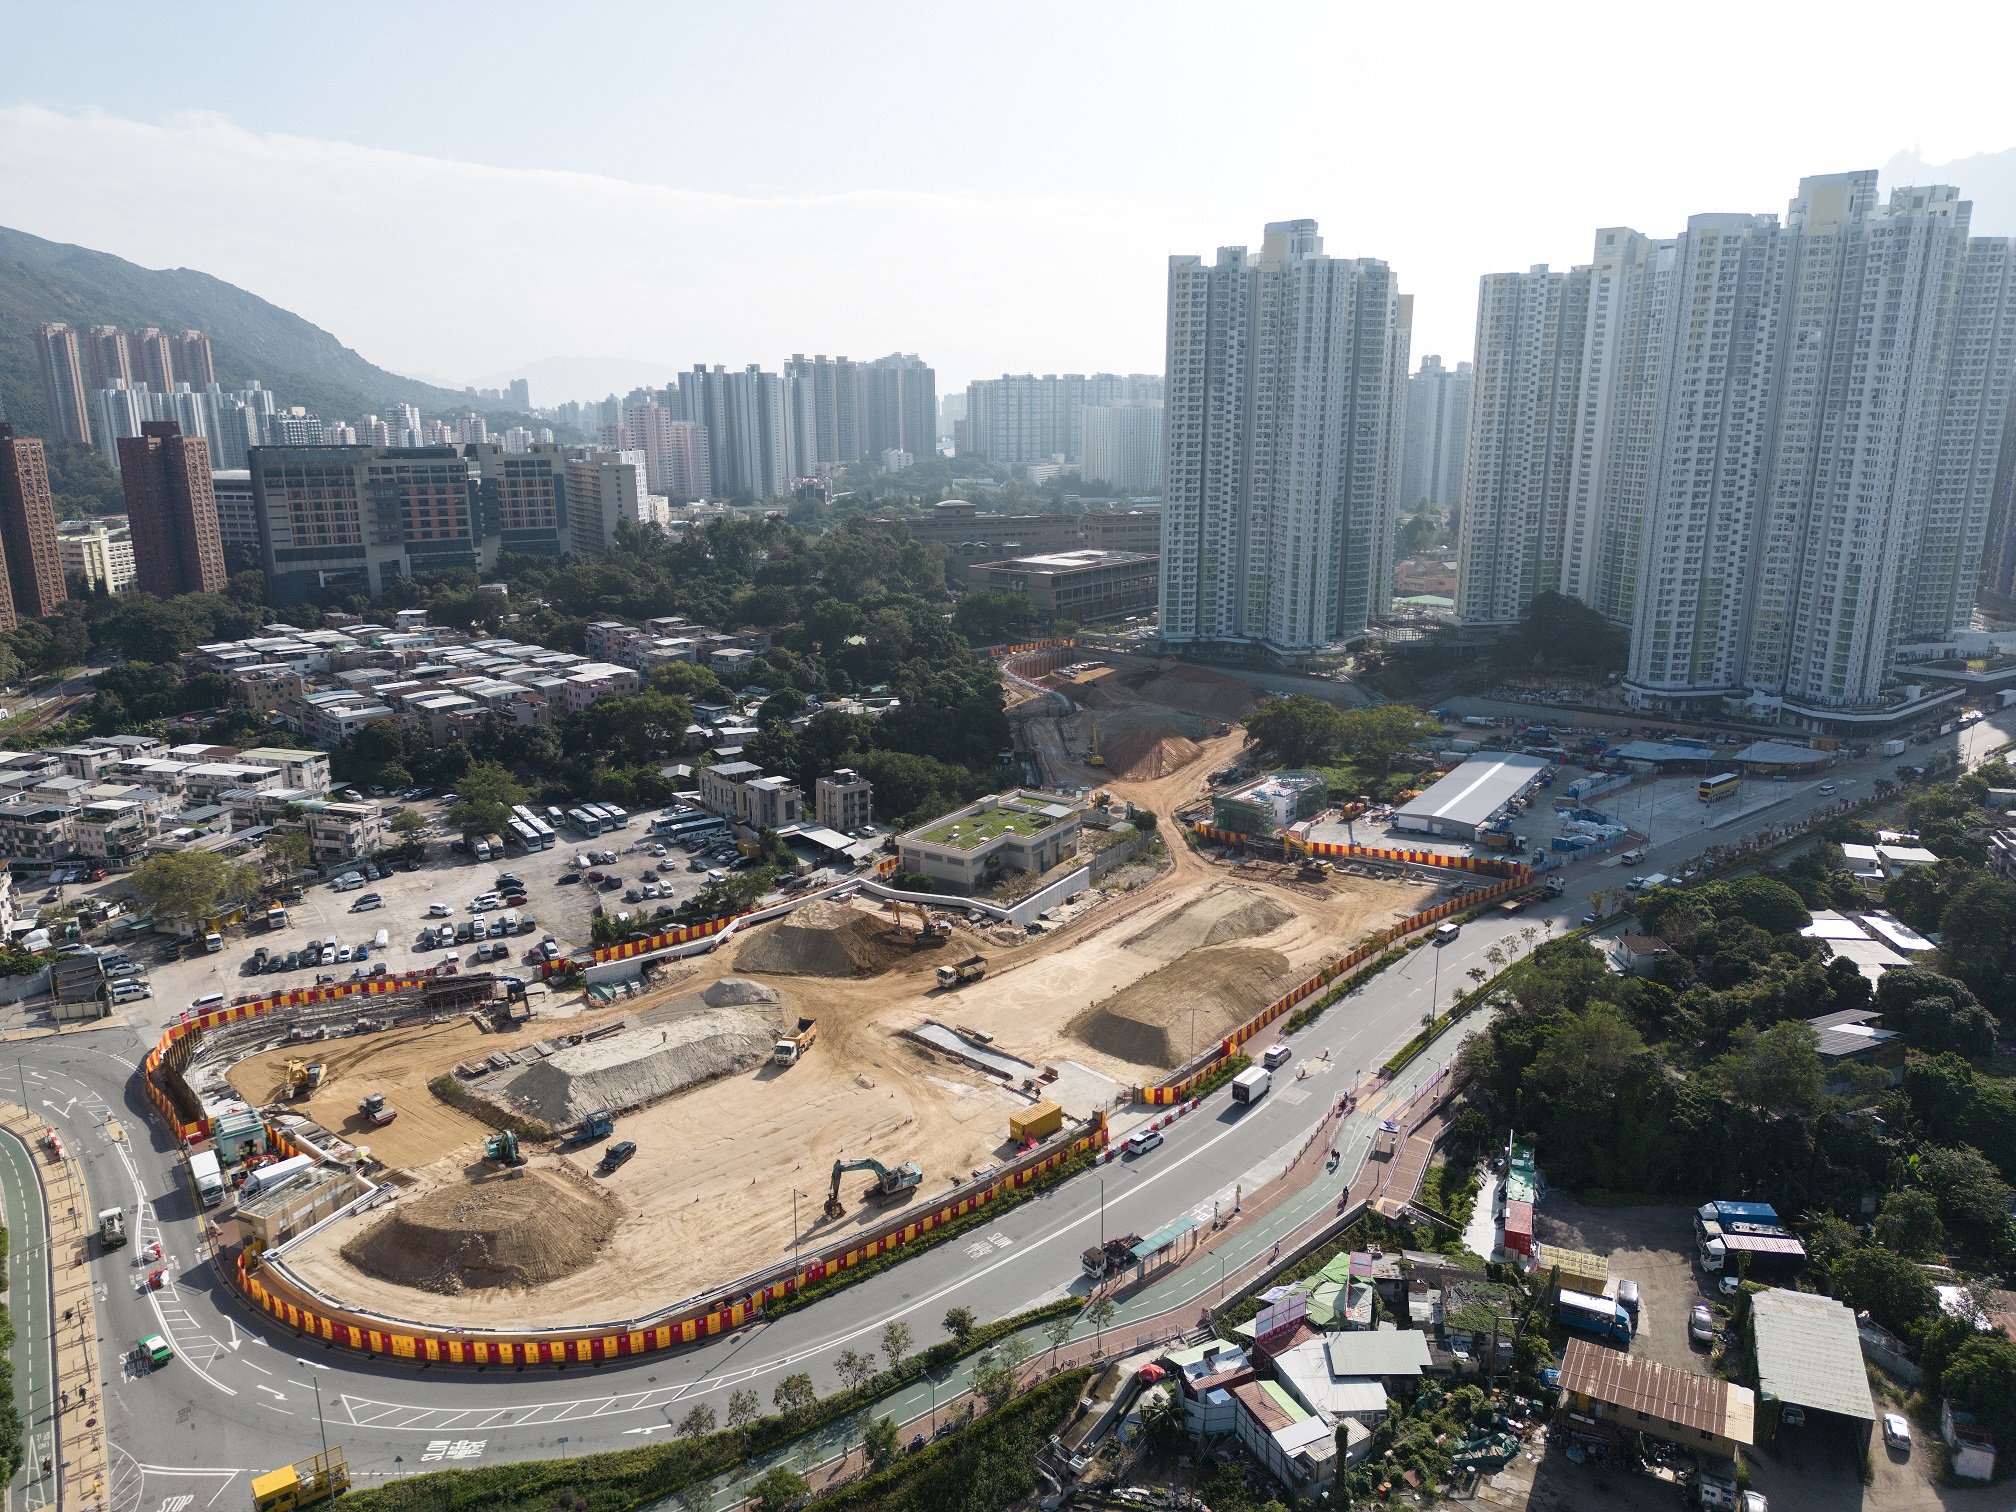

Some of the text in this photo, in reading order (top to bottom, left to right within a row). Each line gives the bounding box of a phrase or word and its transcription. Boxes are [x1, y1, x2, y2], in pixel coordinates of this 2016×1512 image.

[987, 1232, 1013, 1249] SLOW
[420, 1440, 452, 1462] SLOW
[156, 1494, 194, 1512] STOP
